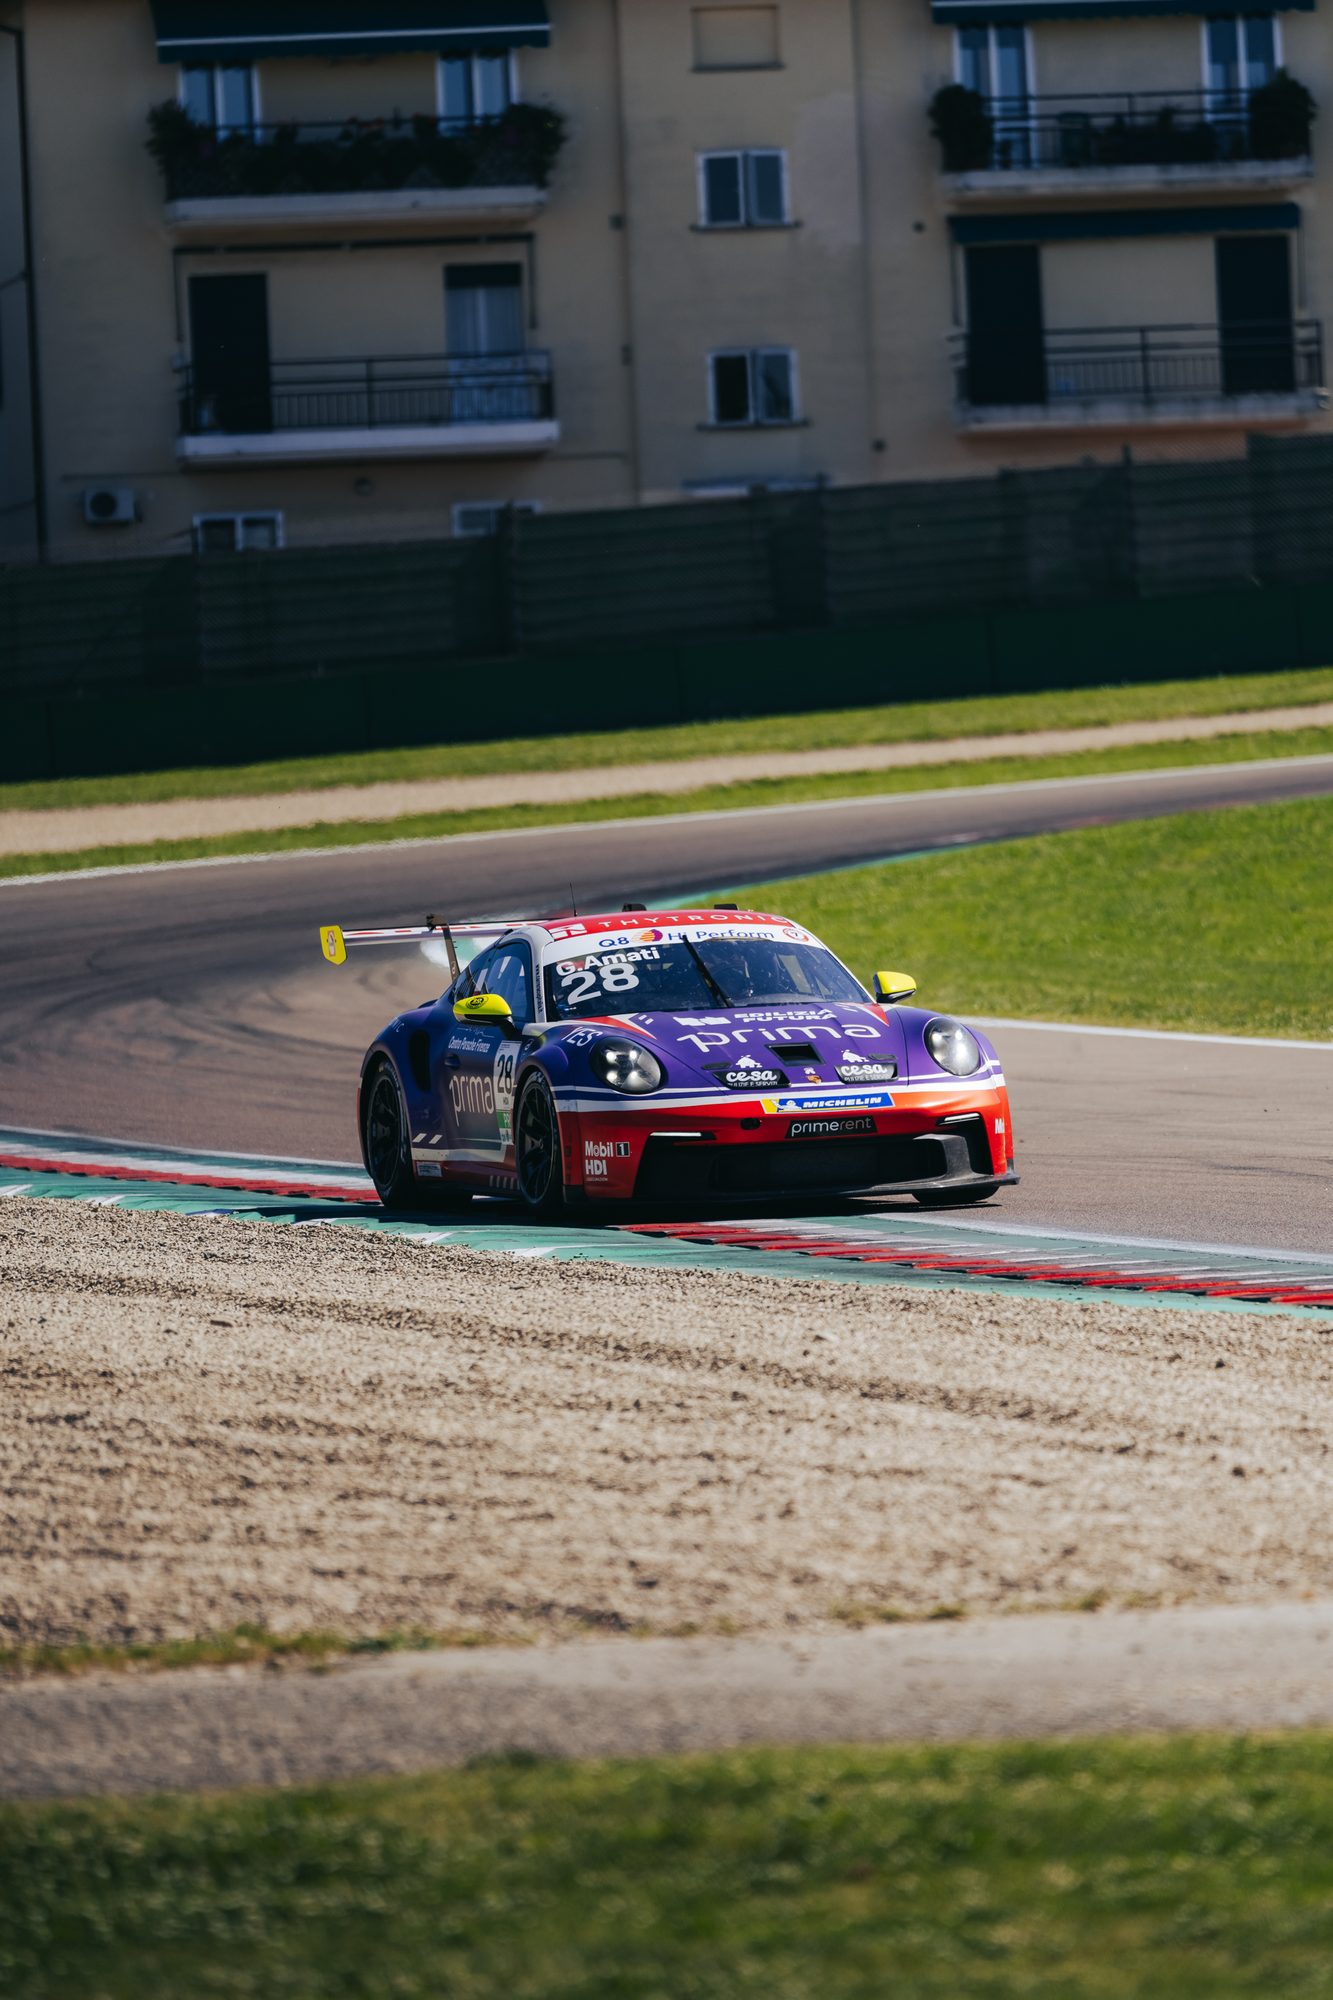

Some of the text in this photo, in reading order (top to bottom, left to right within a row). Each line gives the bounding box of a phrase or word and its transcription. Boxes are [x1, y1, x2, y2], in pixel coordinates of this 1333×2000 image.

[598, 937, 630, 947] Q8
[696, 929, 775, 939] Perform
[556, 947, 661, 976] G.Amati
[561, 963, 640, 1005] 28
[742, 1012, 838, 1023] FUTURA
[561, 1026, 603, 1047] YES
[676, 1024, 882, 1053] prima
[497, 1054, 514, 1095] 28
[725, 1070, 778, 1083] cesa
[841, 1063, 888, 1076] cesa
[449, 1075, 495, 1128] prima
[803, 1096, 882, 1108] MICHELIN
[791, 1117, 872, 1137] primerent
[585, 1141, 614, 1157] Mobil
[585, 1159, 608, 1175] HDI
